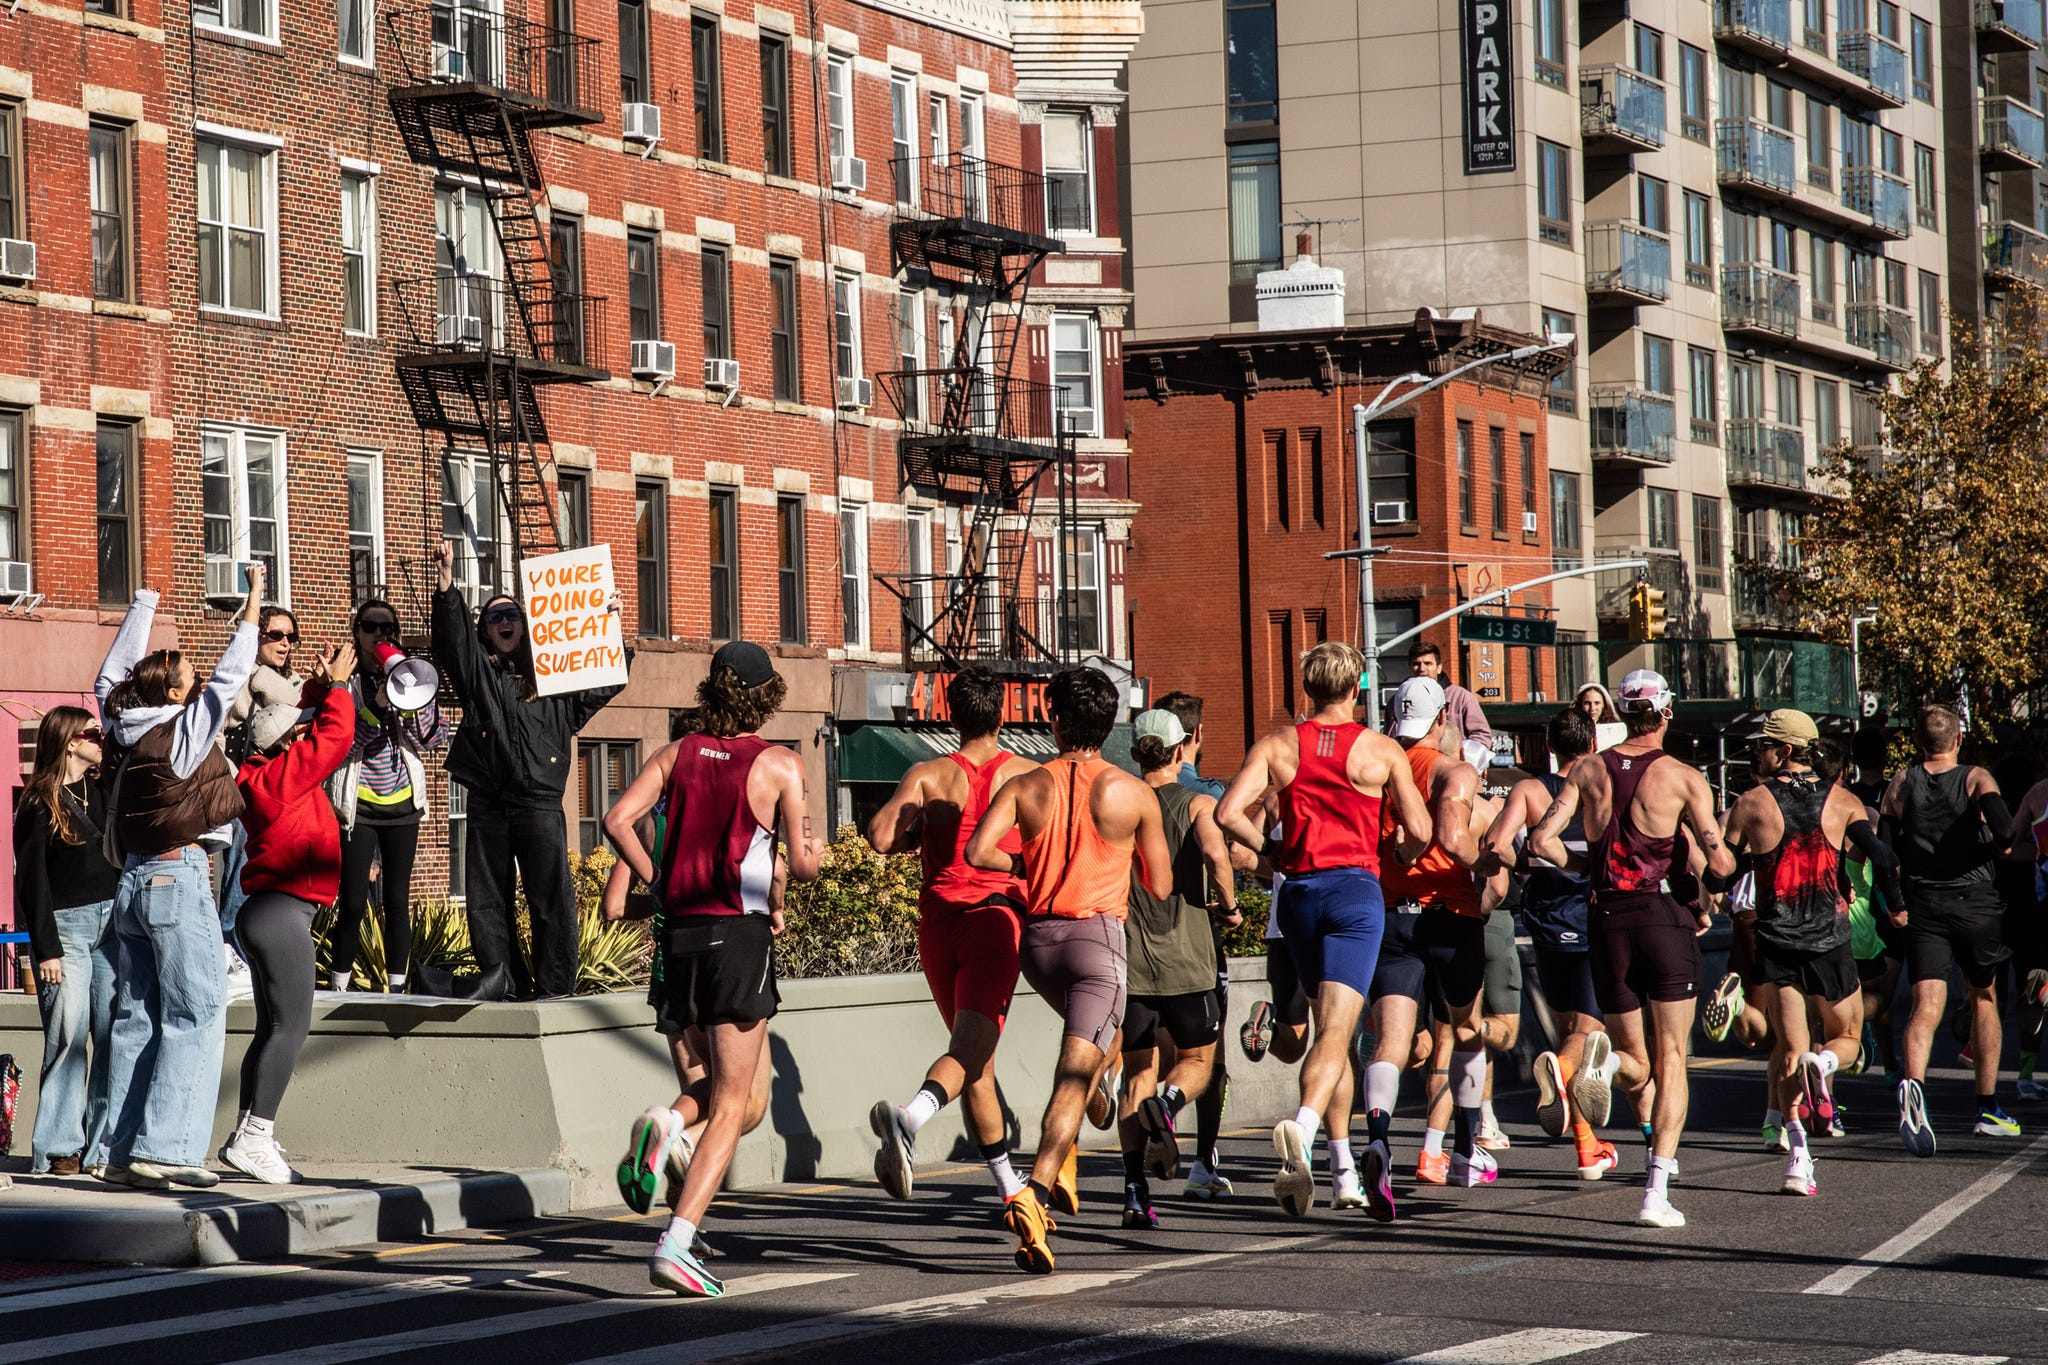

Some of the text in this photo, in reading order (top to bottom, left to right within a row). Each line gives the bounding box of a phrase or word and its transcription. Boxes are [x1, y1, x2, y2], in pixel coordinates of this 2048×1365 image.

[1475, 4, 1502, 136] PARK
[1473, 141, 1509, 152] ENTER ON
[530, 589, 604, 619] DOING
[532, 613, 613, 646] GREAT
[1487, 622, 1530, 639] 13 St
[535, 645, 623, 676] SWEATY!
[1478, 671, 1496, 682] Spa
[1483, 688, 1499, 697] 203
[700, 747, 731, 761] BOWMEN
